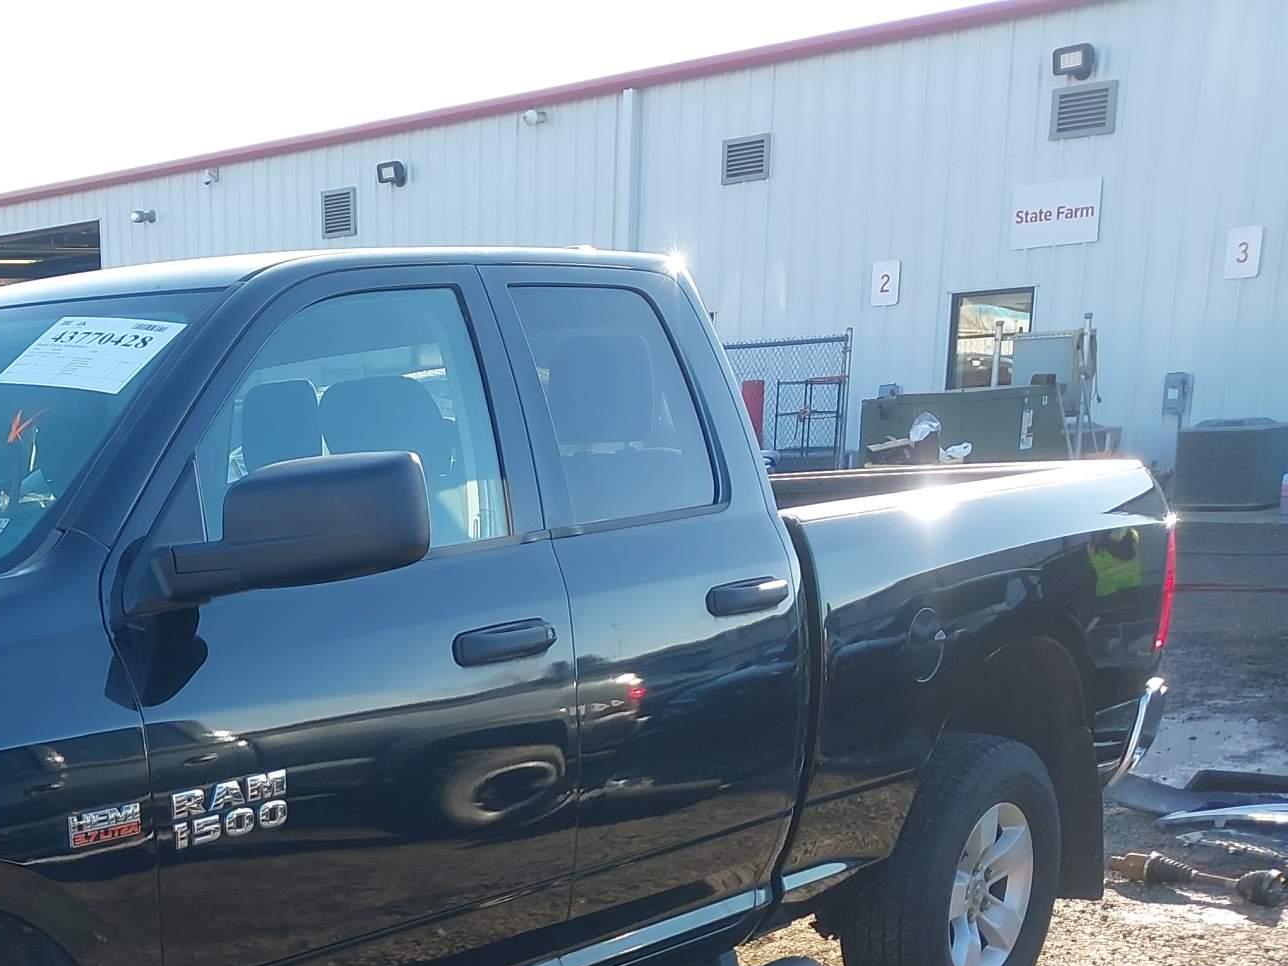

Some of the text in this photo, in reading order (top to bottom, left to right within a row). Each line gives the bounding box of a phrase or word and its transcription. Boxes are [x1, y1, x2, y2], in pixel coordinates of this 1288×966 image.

[1015, 205, 1095, 224] State Farm
[1236, 242, 1249, 263] 3
[880, 273, 890, 293] 2
[50, 330, 154, 349] 43770428
[172, 768, 287, 820] RAM
[68, 802, 141, 833] HEMI
[173, 799, 288, 850] 1500
